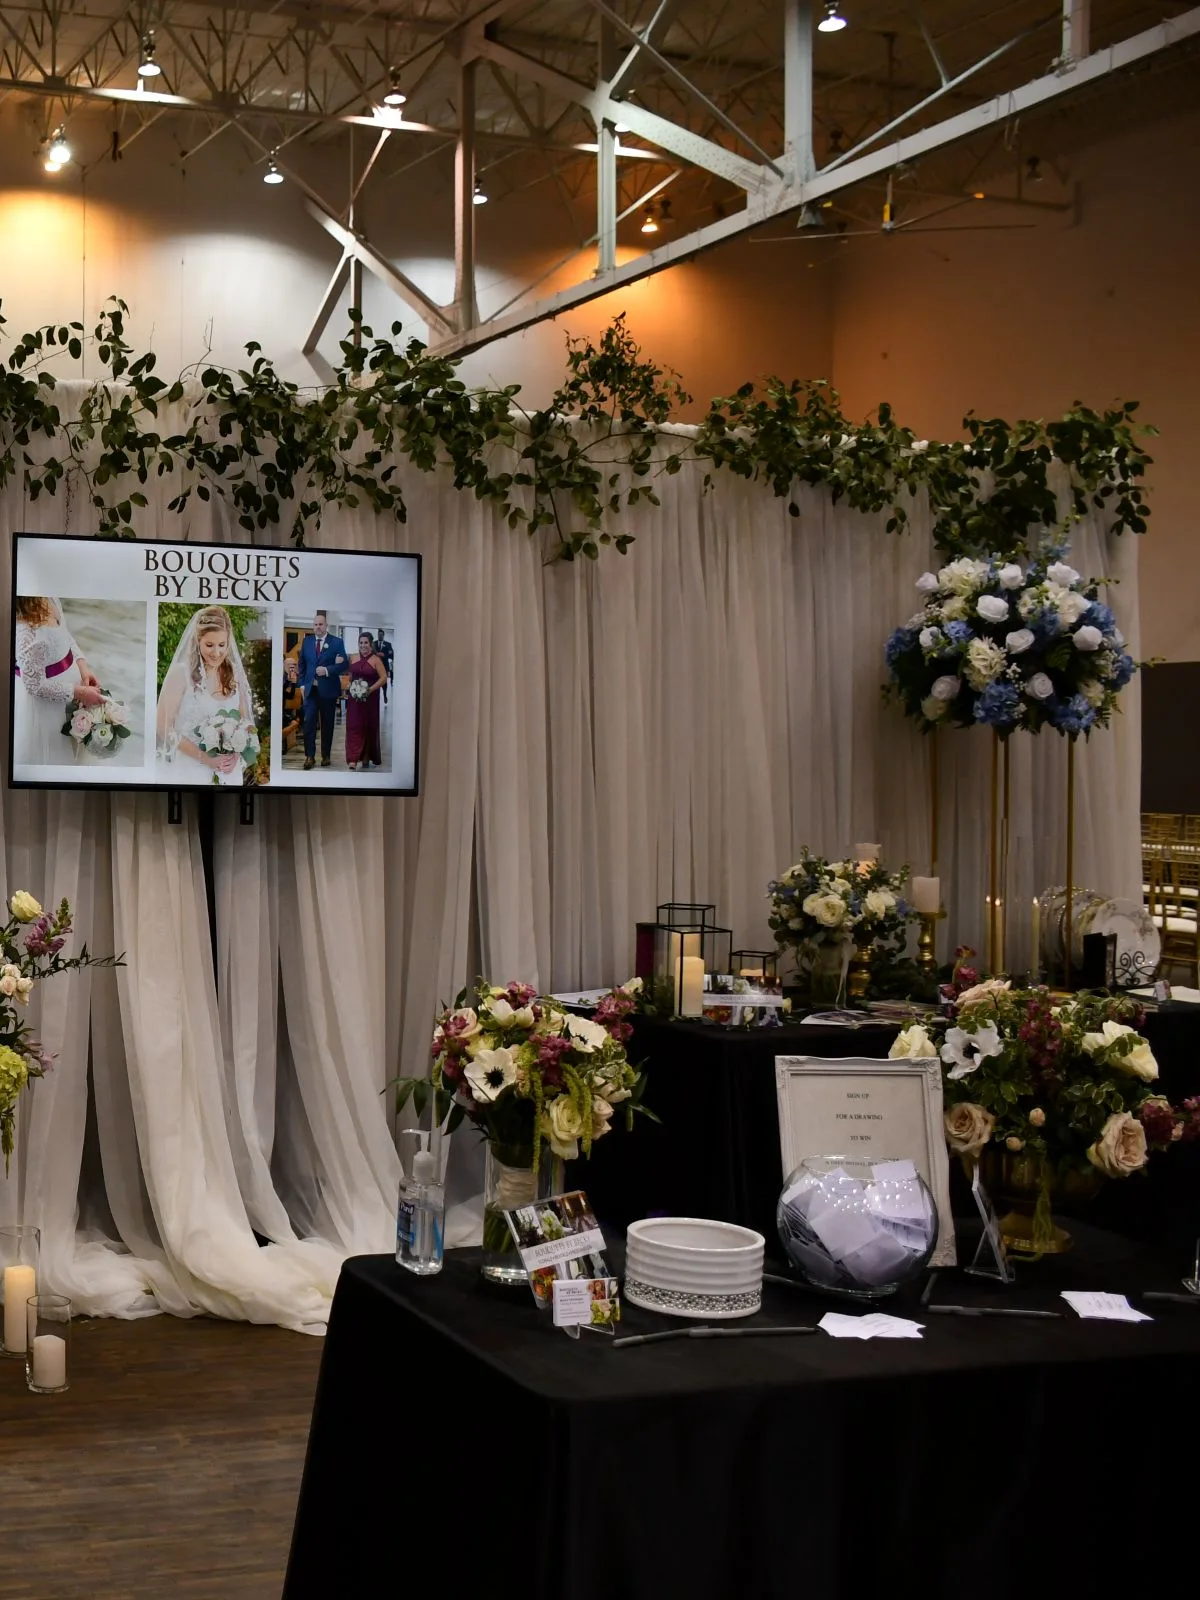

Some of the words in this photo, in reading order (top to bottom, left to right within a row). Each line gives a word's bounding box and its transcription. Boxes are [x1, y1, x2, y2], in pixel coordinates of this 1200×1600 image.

[143, 548, 300, 580] BOUQUETS
[154, 574, 189, 598] BY
[198, 576, 288, 602] BECKY
